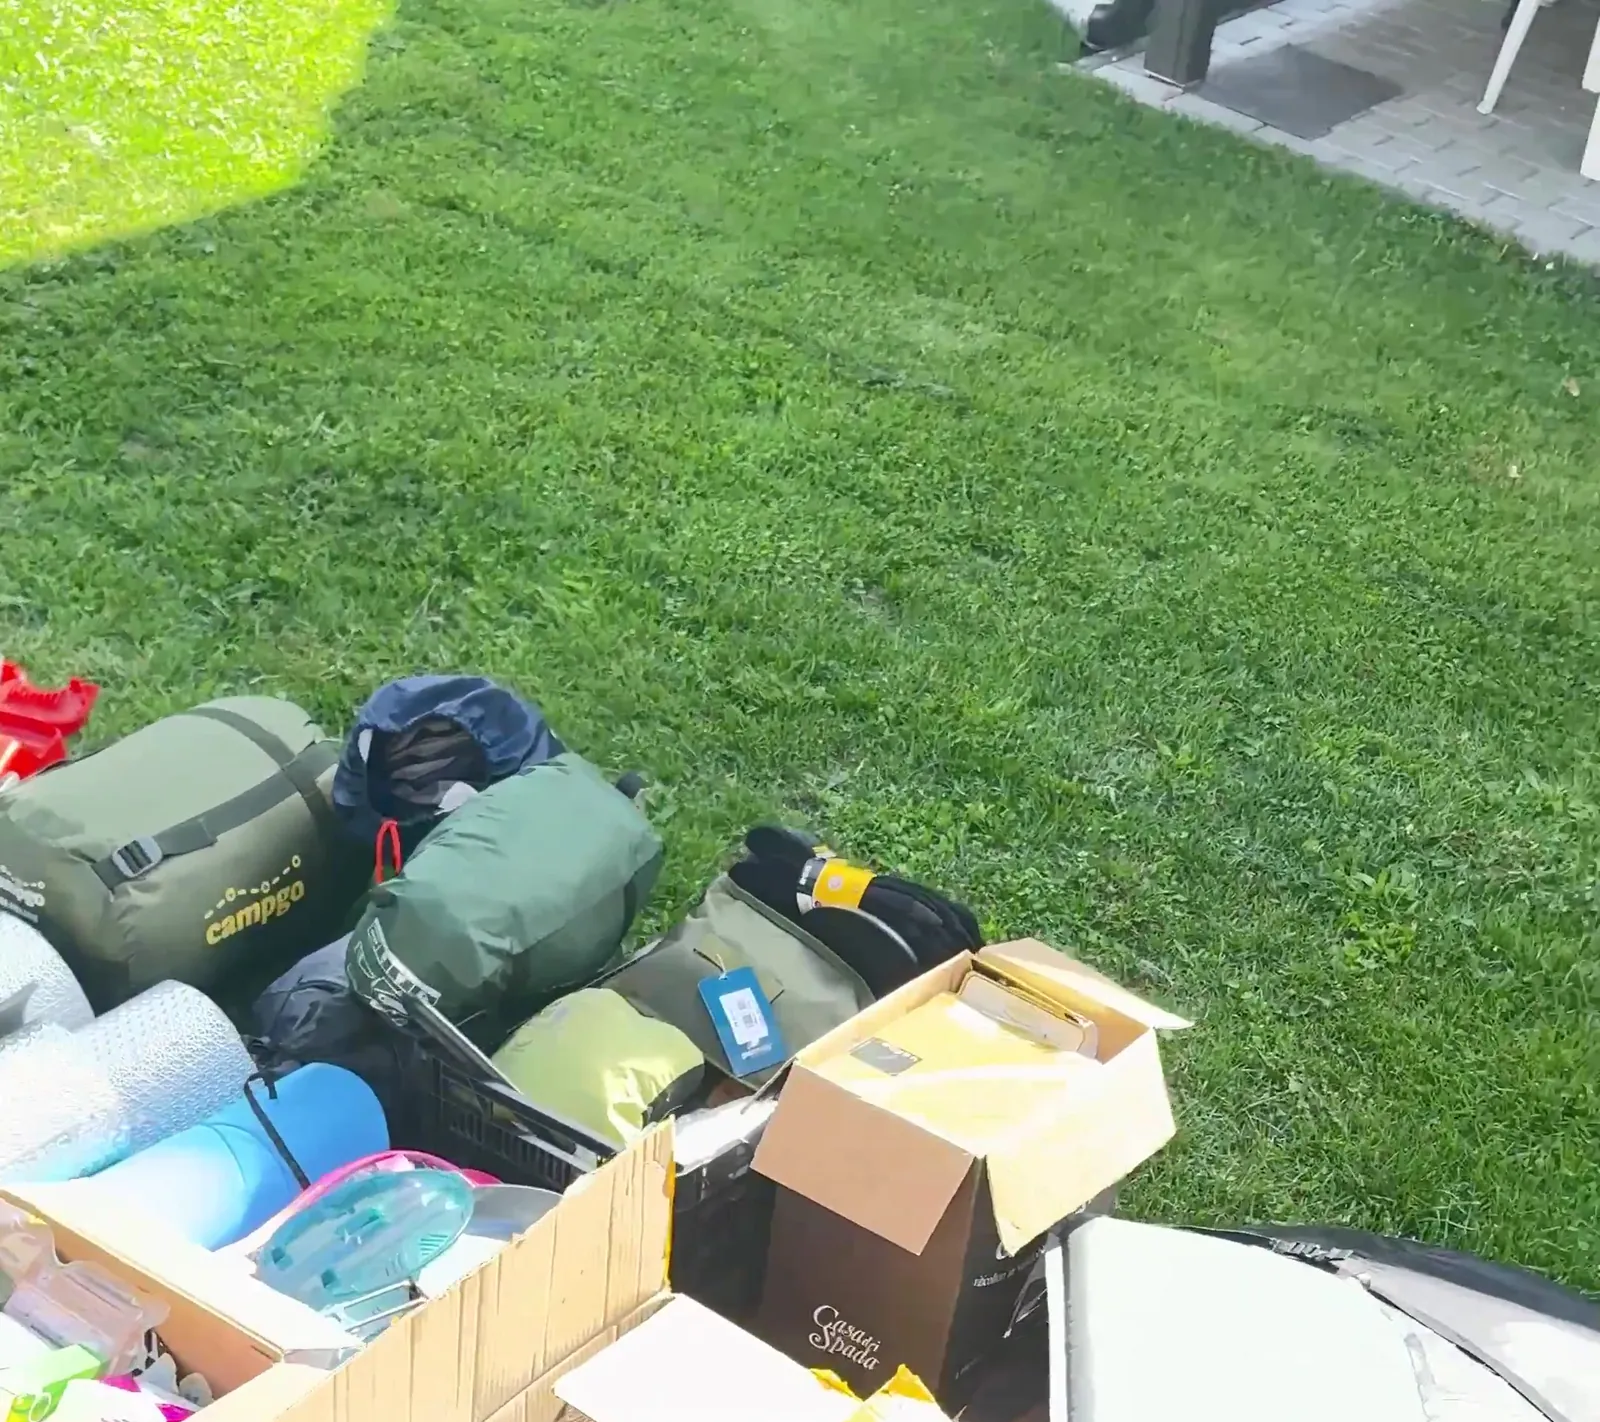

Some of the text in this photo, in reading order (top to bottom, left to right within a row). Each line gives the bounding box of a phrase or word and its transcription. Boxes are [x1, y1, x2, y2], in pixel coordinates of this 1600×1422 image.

[206, 880, 304, 945] campgo
[813, 1305, 866, 1343] Casa
[808, 1325, 880, 1370] Spada
